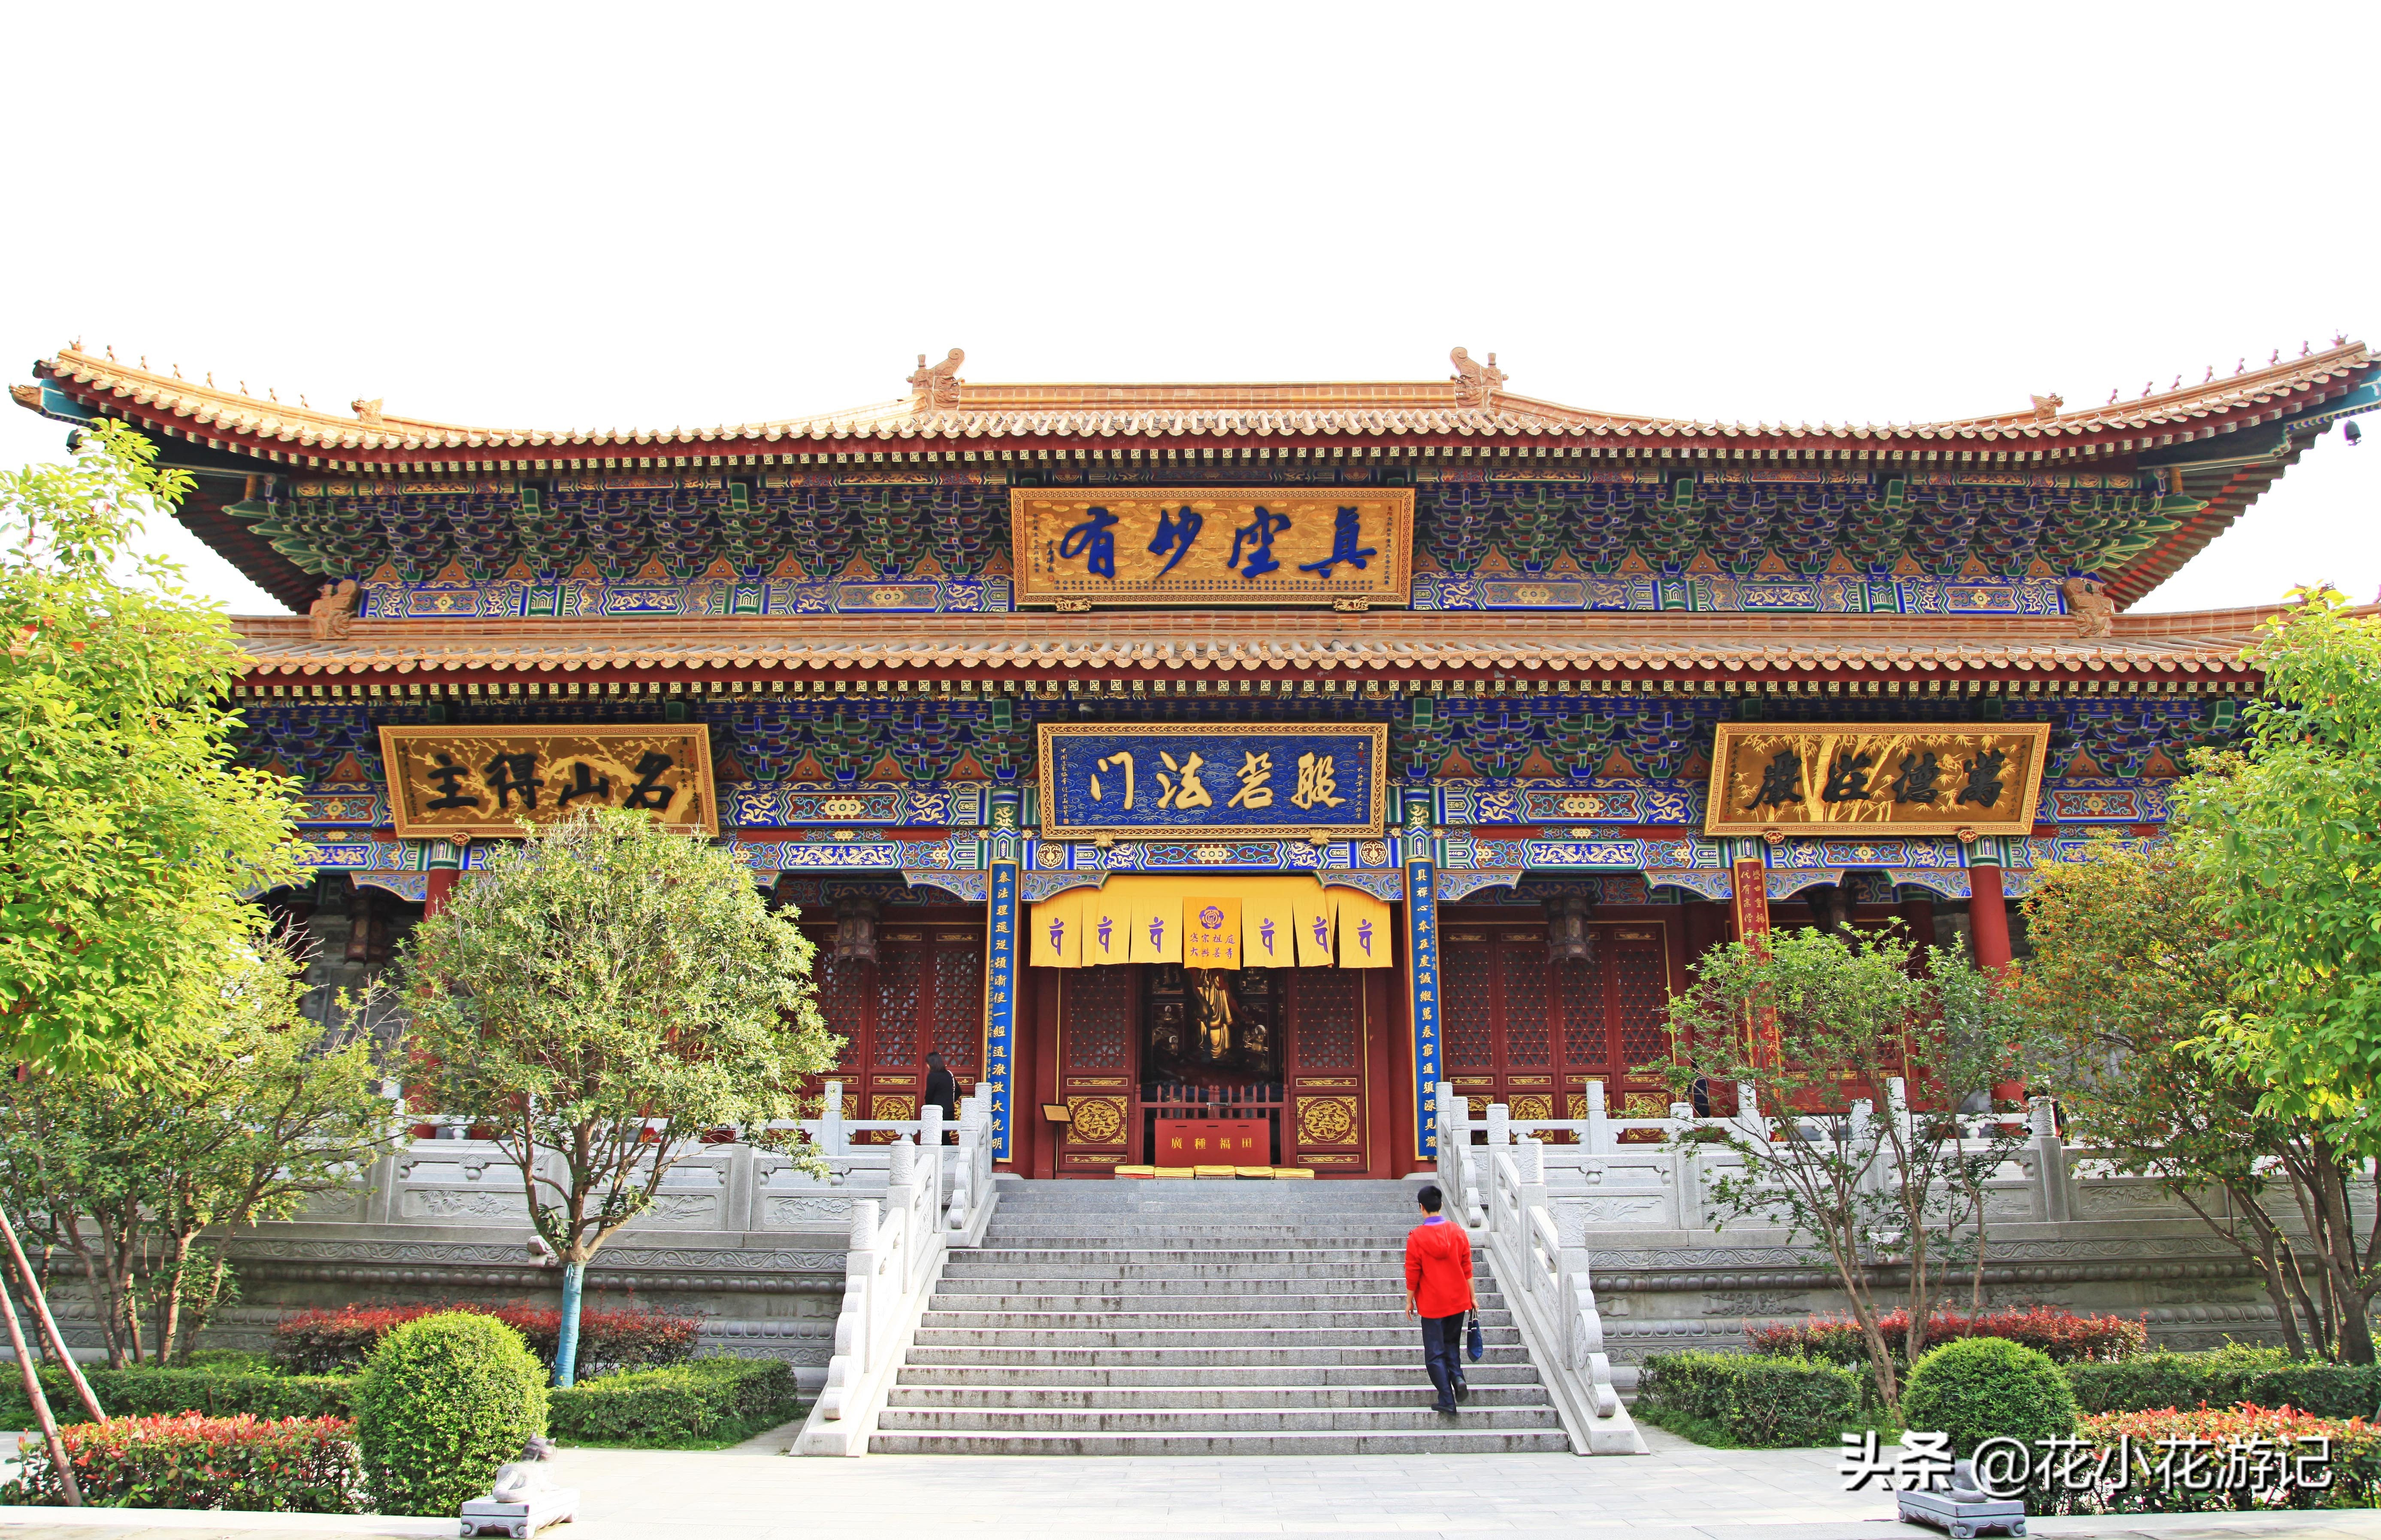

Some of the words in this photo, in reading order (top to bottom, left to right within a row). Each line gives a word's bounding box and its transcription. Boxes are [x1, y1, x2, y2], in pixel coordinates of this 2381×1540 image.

[426, 750, 675, 809] 名山得主
[1189, 932, 1236, 944] 密宗祖庭
[1171, 1136, 1252, 1150] 廣種福田
